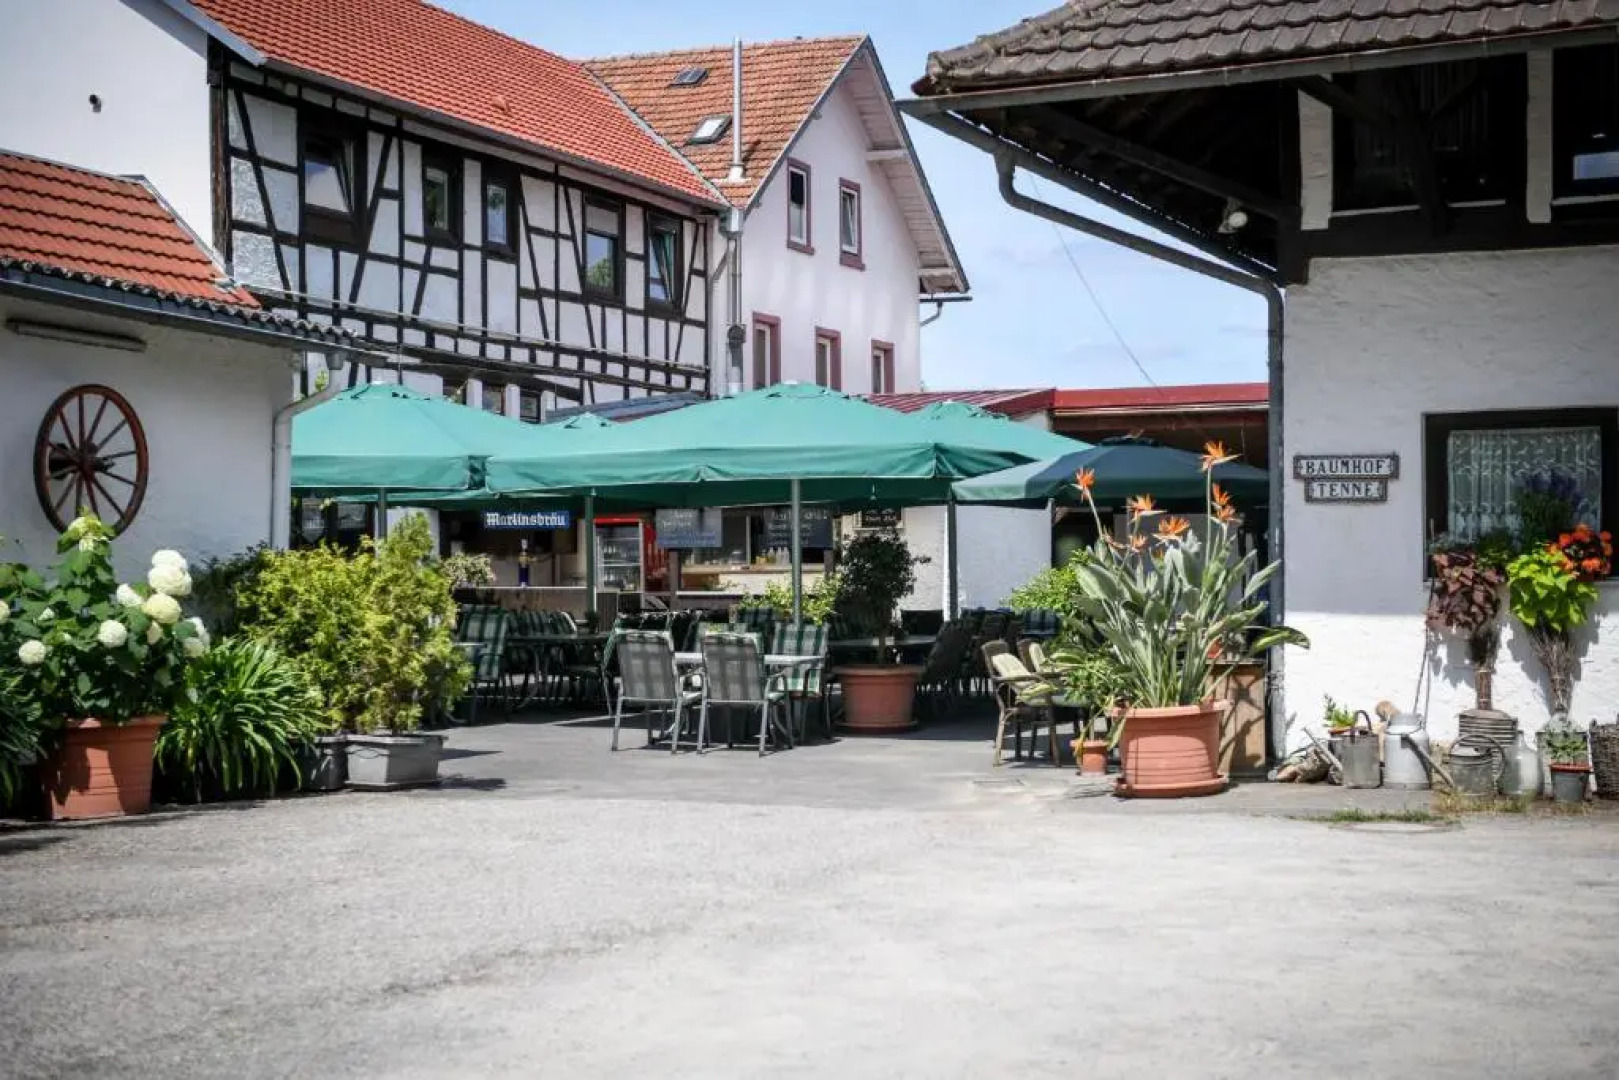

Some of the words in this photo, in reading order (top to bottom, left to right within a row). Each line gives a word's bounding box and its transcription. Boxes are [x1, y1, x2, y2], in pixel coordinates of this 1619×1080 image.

[1305, 459, 1385, 474] BAUMHOF
[1317, 483, 1373, 498] TENNE
[486, 511, 566, 527] Martinsbräu
